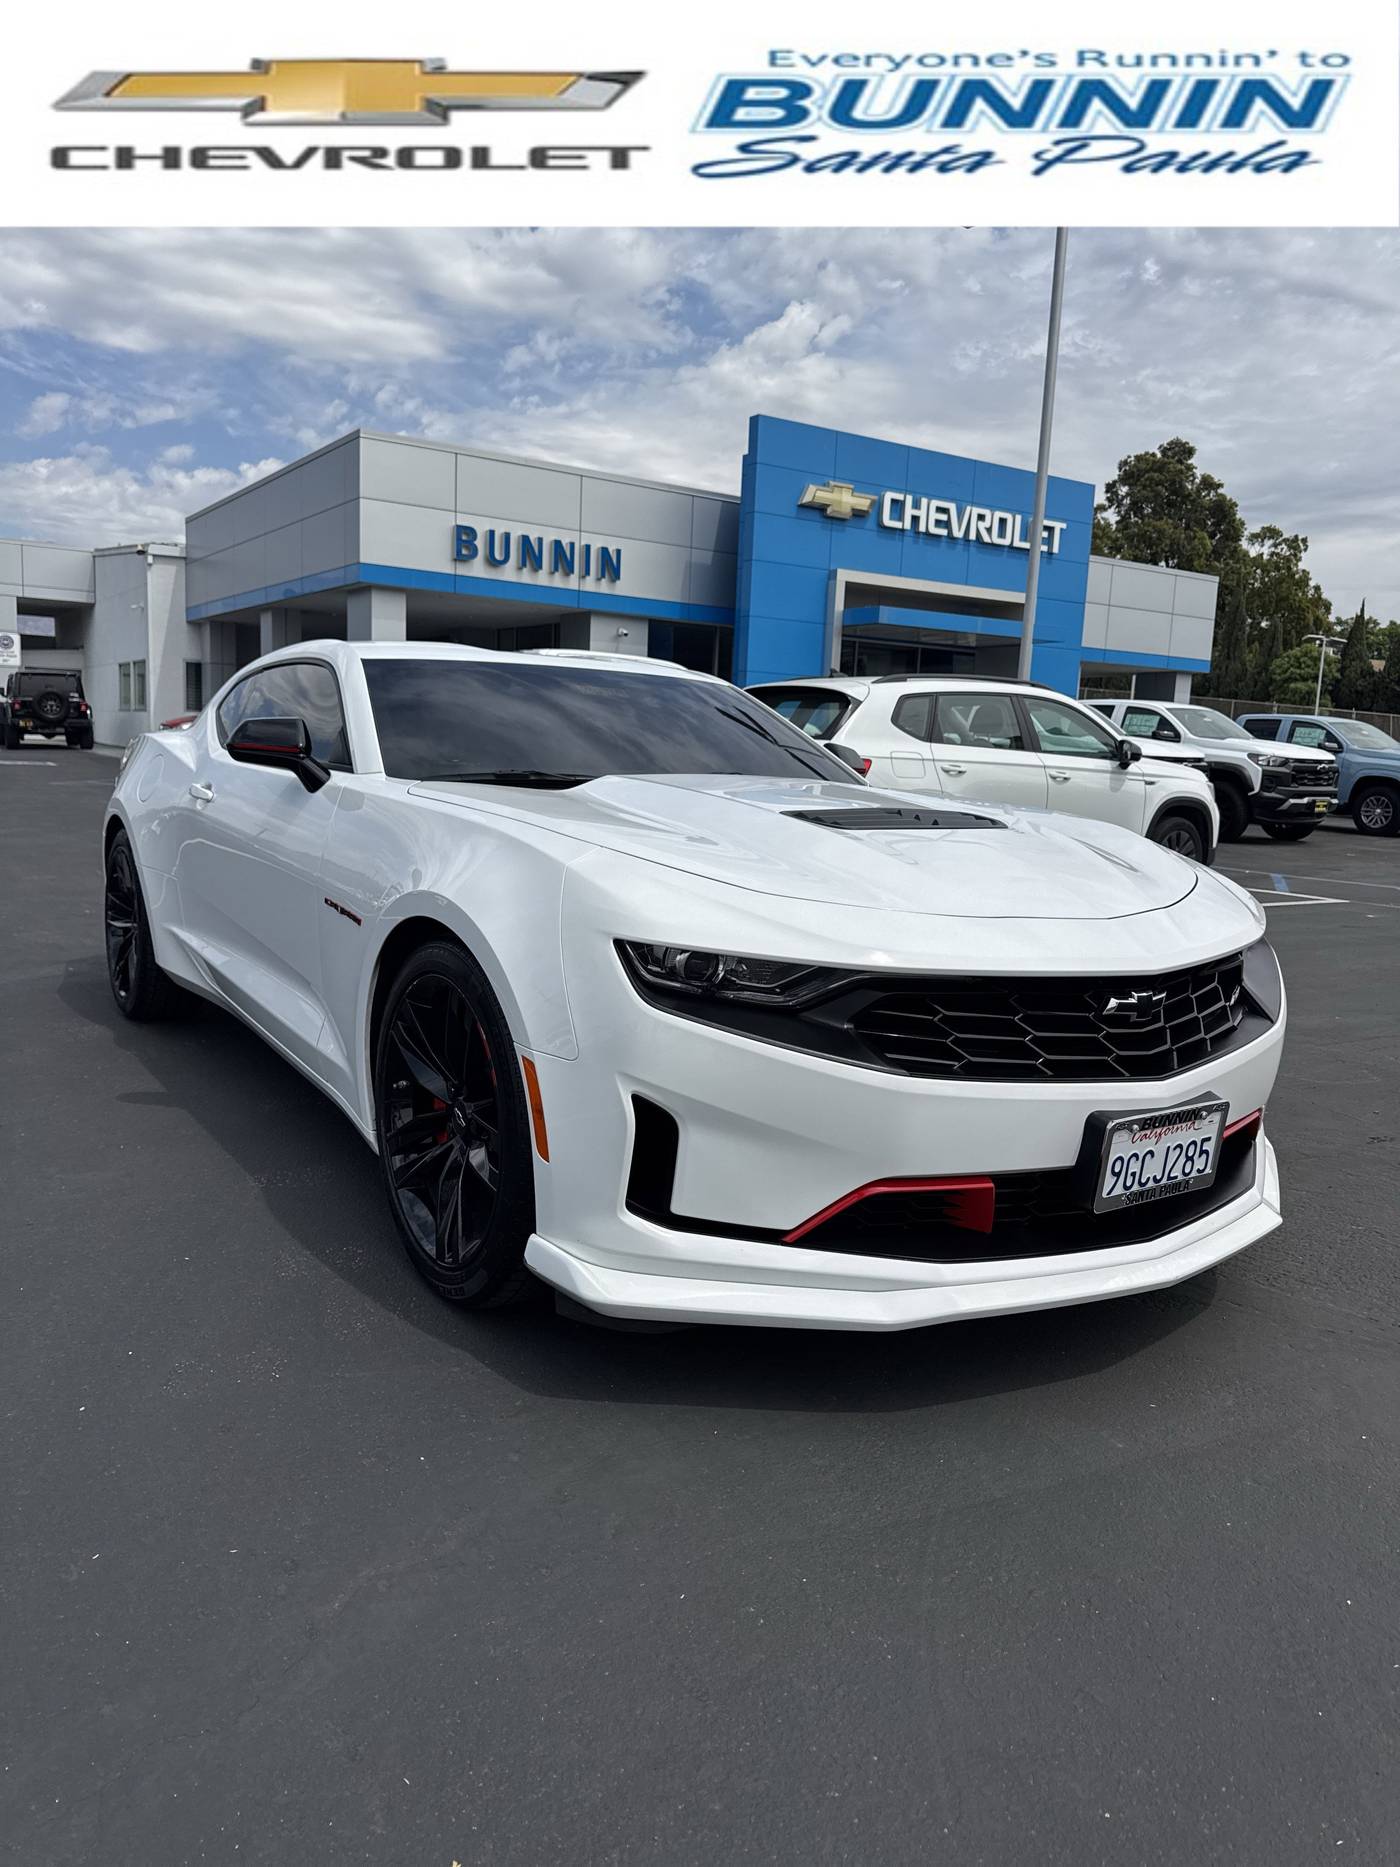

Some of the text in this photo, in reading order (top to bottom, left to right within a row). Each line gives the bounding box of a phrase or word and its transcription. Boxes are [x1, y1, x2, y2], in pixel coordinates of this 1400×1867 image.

[453, 524, 622, 583] BUNNIN
[1141, 1107, 1202, 1131] BUNNIN
[1131, 1121, 1203, 1145] California
[1106, 1136, 1212, 1196] 9GCJ285
[1125, 1180, 1190, 1205] SANTA PAULA
